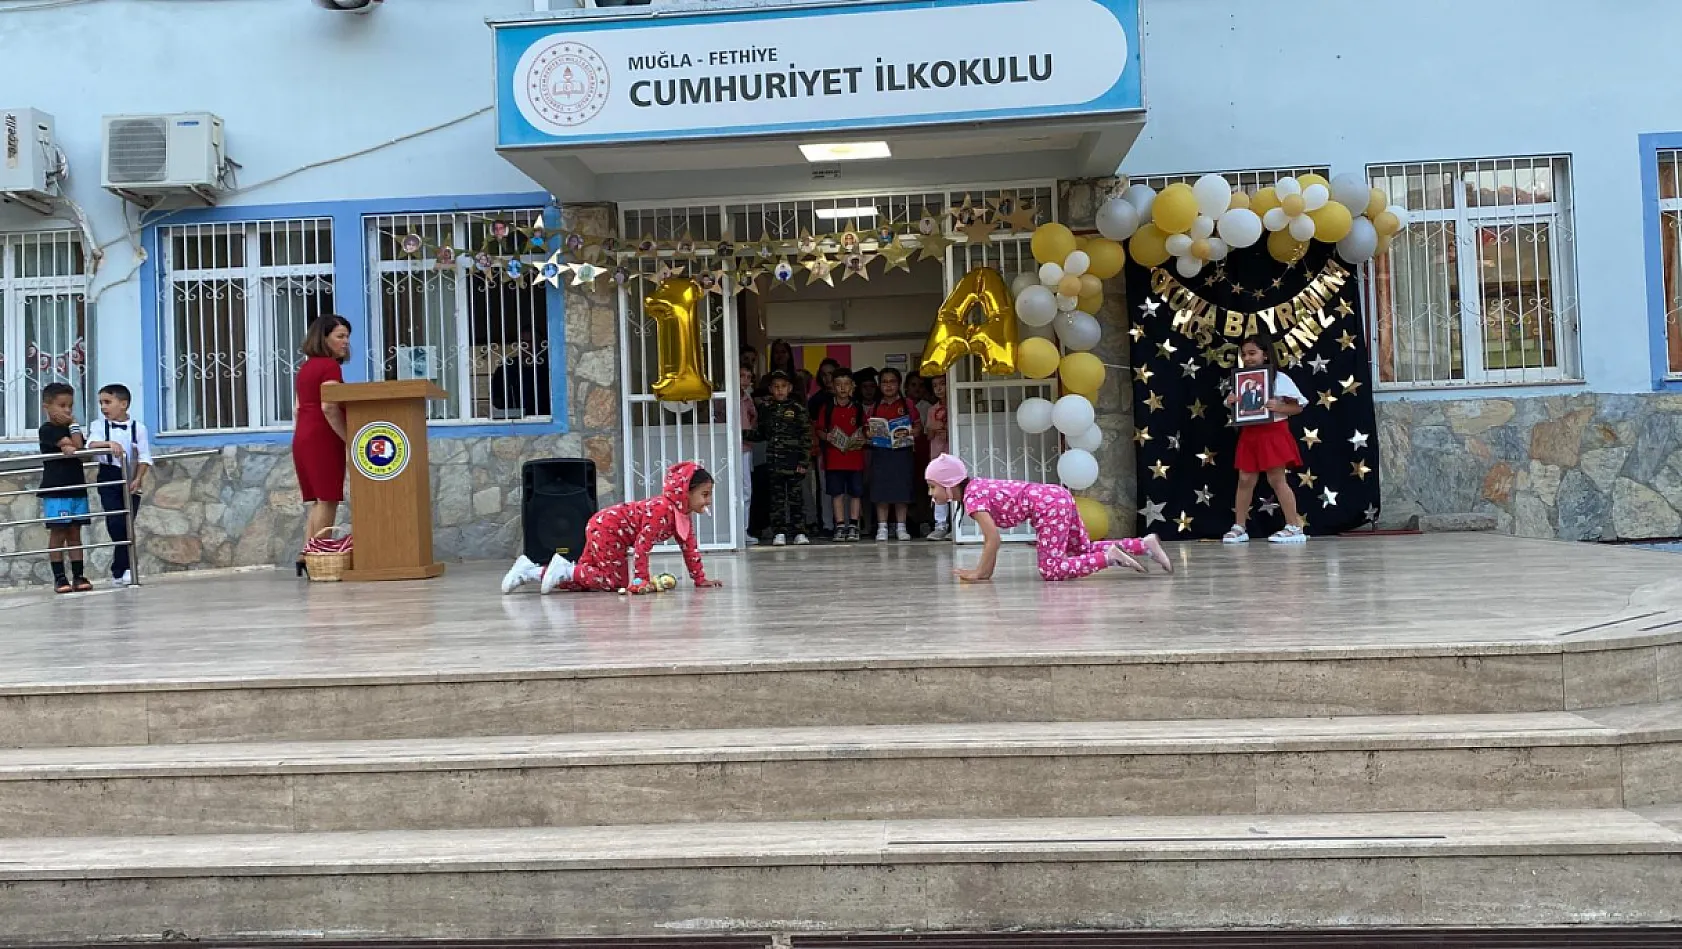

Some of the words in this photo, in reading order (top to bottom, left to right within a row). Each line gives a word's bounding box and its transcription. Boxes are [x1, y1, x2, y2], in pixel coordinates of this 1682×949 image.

[628, 51, 692, 70] MUĞLA
[709, 45, 777, 65] FETHİYE
[629, 62, 863, 107] CUMHURİYET
[875, 53, 1052, 92] İLKOKULU
[645, 277, 713, 400] 1
[920, 267, 1018, 376] A
